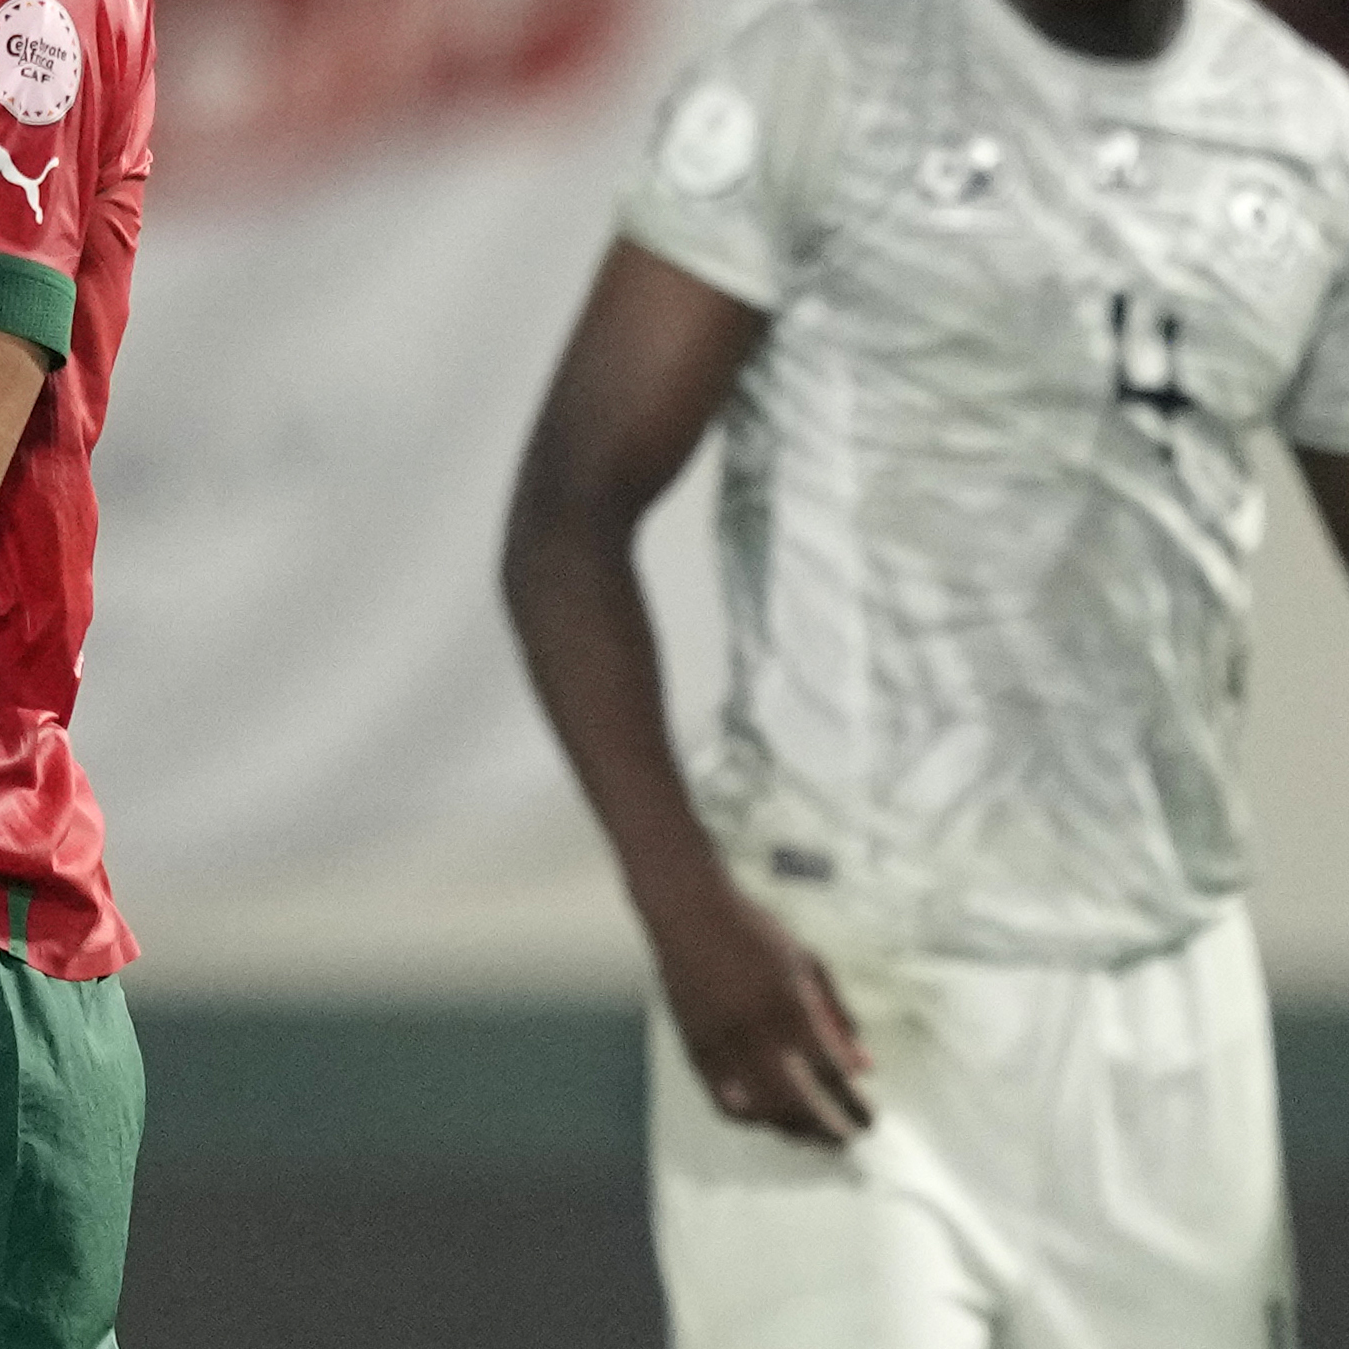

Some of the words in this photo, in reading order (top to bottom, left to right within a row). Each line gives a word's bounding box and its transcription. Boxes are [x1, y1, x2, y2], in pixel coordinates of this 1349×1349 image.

[6, 34, 68, 62] Celebrate
[18, 48, 55, 70] Africa
[20, 67, 52, 83] CAF
[1107, 291, 1195, 456] 4
